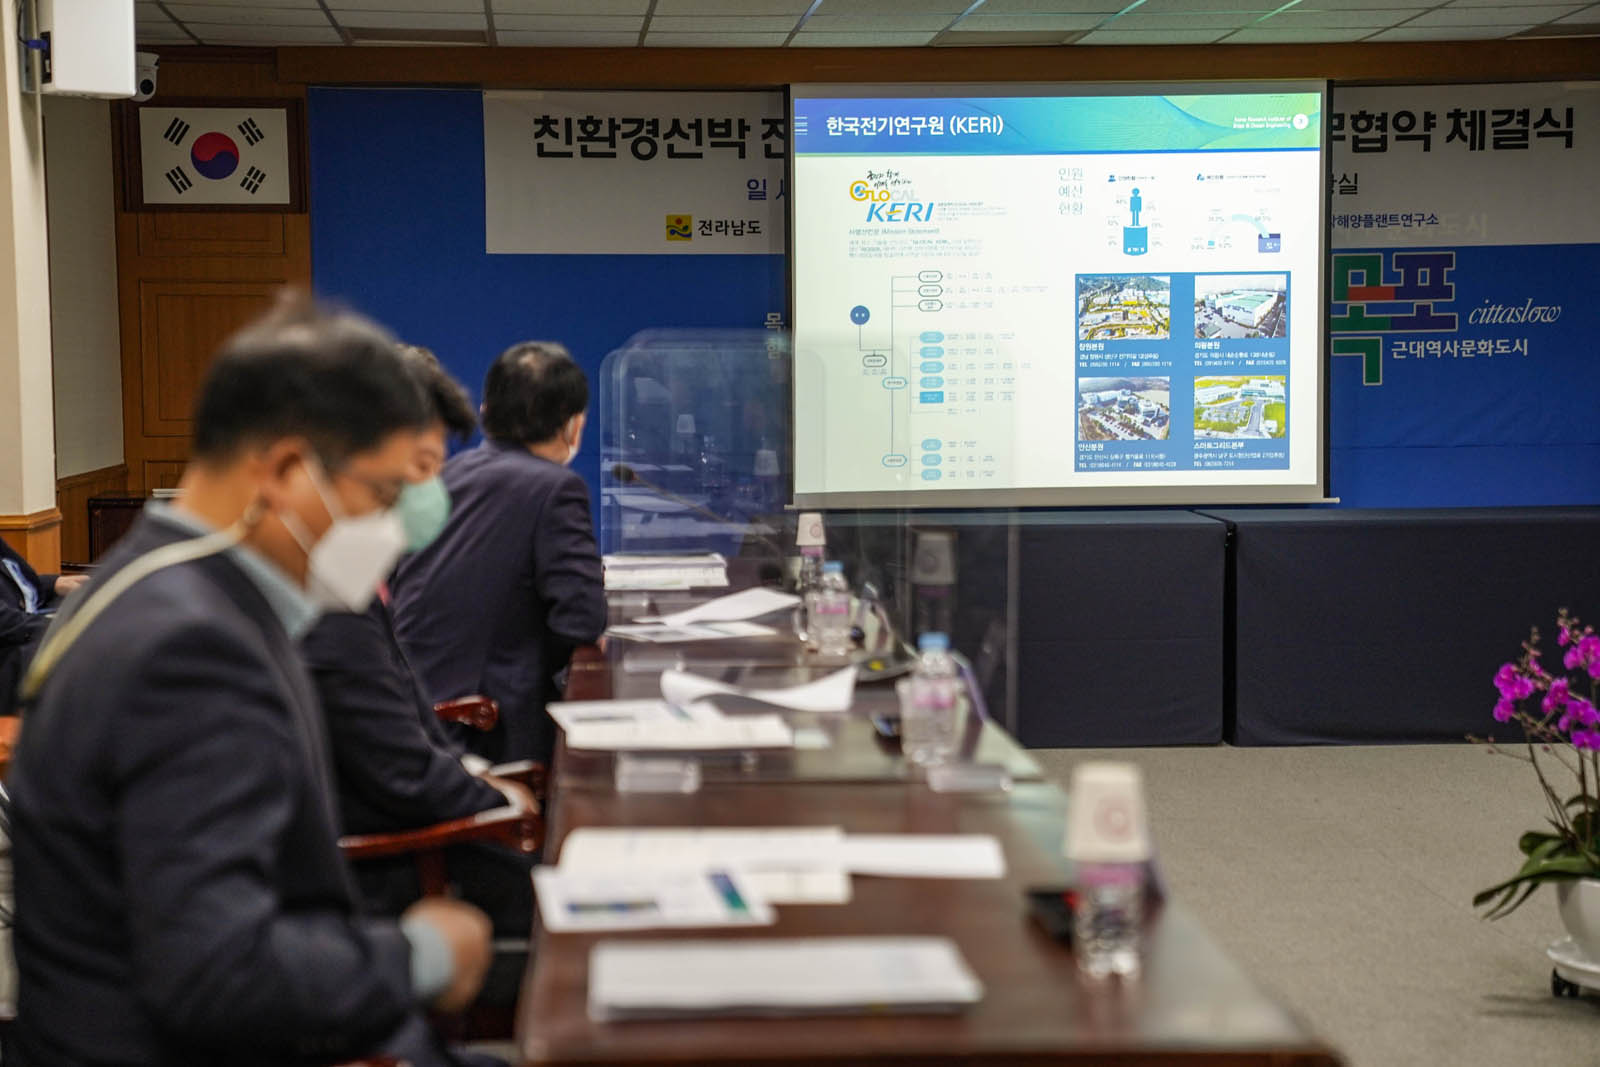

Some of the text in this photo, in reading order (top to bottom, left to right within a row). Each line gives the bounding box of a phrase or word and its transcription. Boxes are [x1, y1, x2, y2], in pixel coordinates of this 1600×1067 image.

[826, 115, 1004, 136] 한국전기연구원 (KERI)
[1446, 107, 1575, 151] 체결식
[533, 115, 751, 161] 친환경선박
[747, 178, 767, 201] 일
[866, 202, 934, 223] KERI
[698, 219, 762, 236] 전라남도
[1468, 298, 1562, 325] cittaslow
[1391, 338, 1529, 359] 근대역사문화도시
